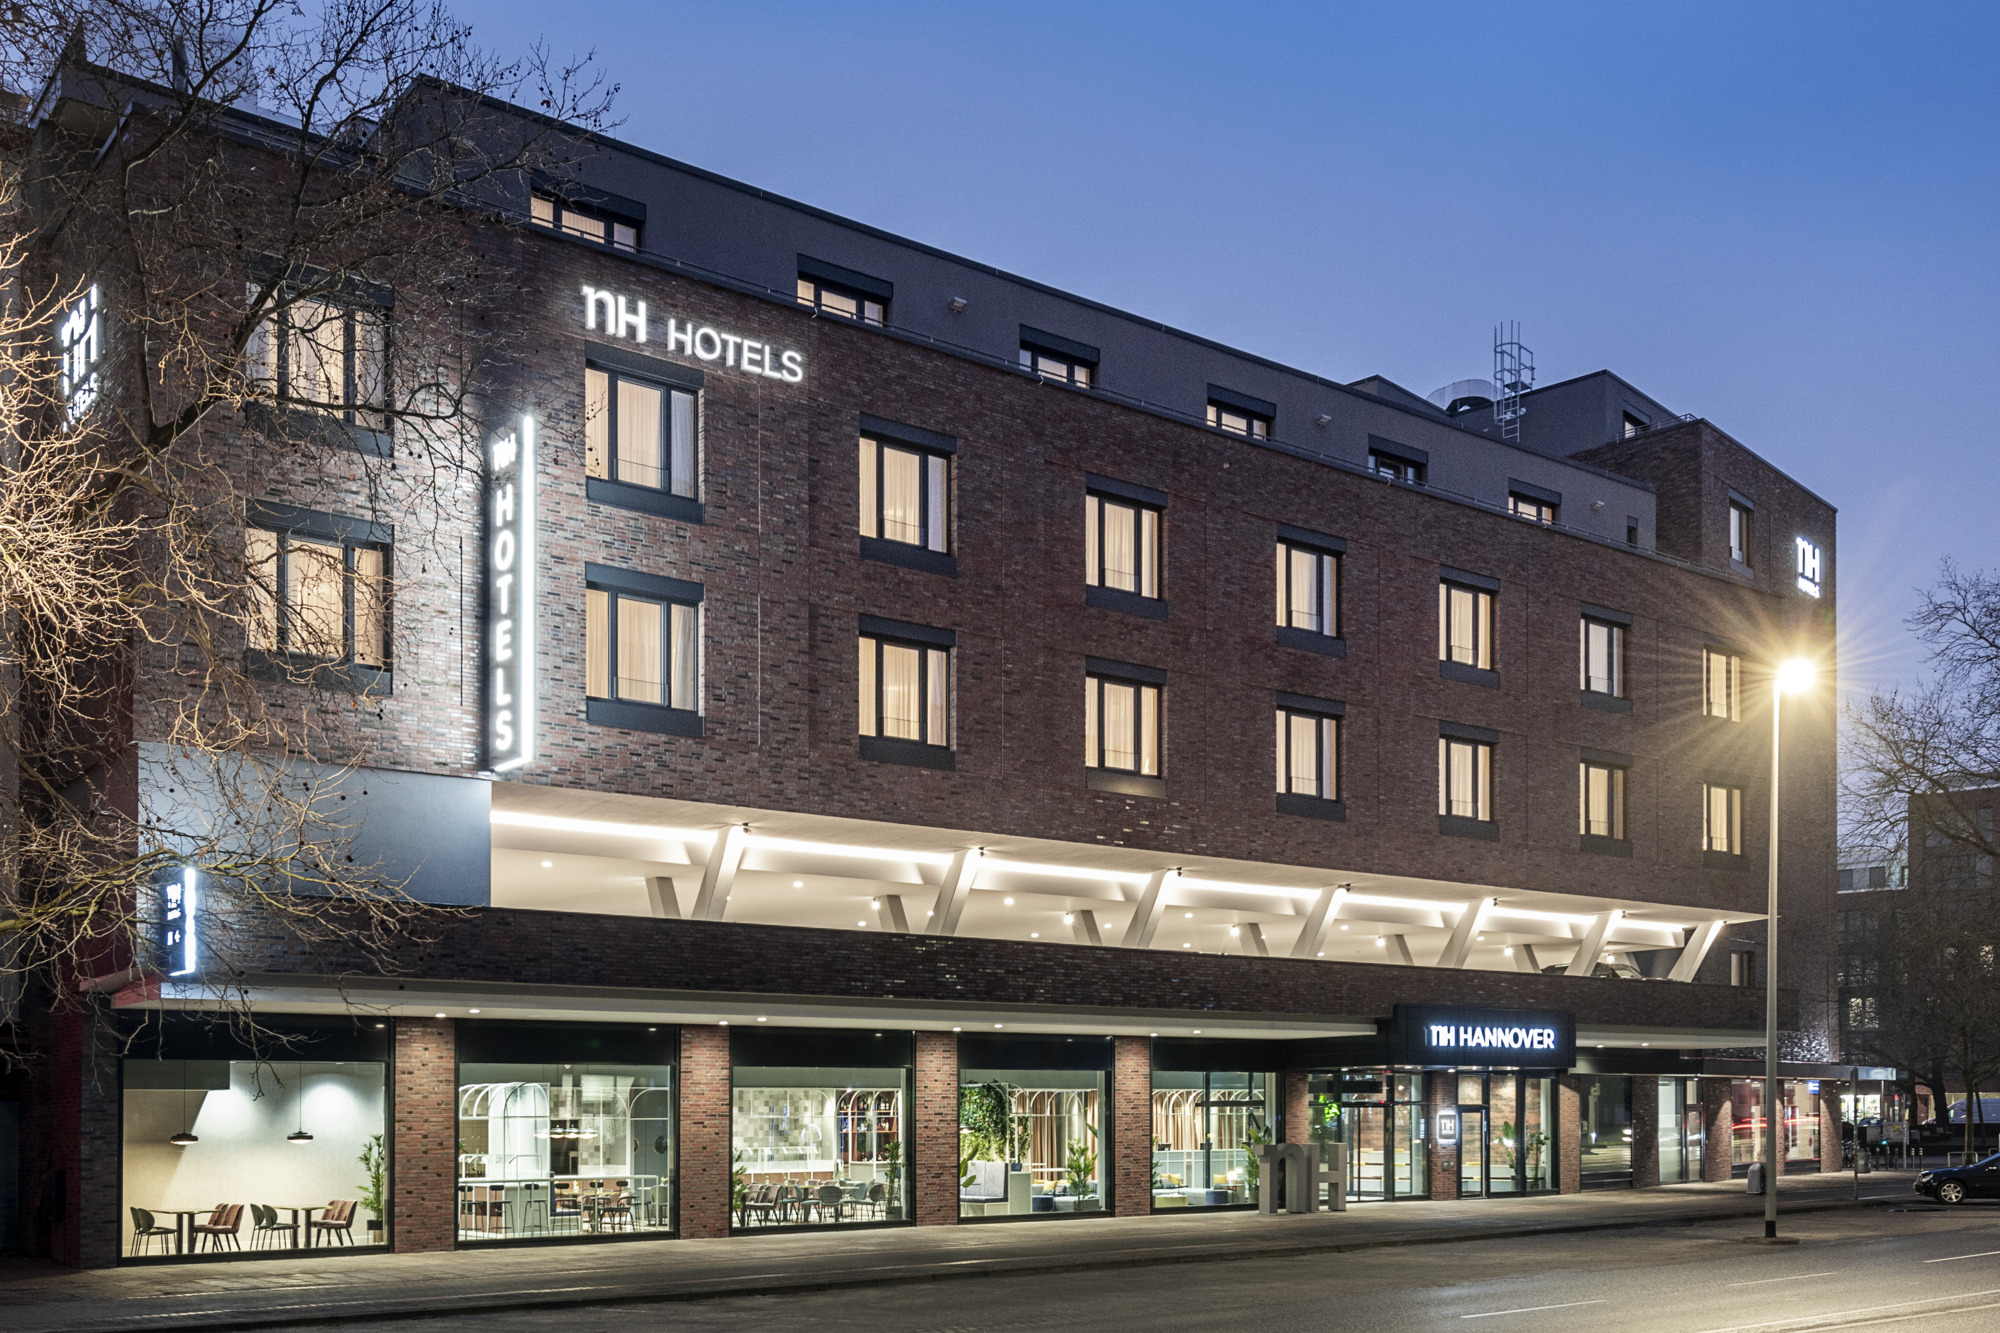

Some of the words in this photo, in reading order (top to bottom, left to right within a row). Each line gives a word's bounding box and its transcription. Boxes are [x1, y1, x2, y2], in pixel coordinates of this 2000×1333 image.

[667, 317, 804, 383] HOTELS
[494, 483, 515, 750] HOTELS
[1459, 1026, 1555, 1049] HANNOVER
